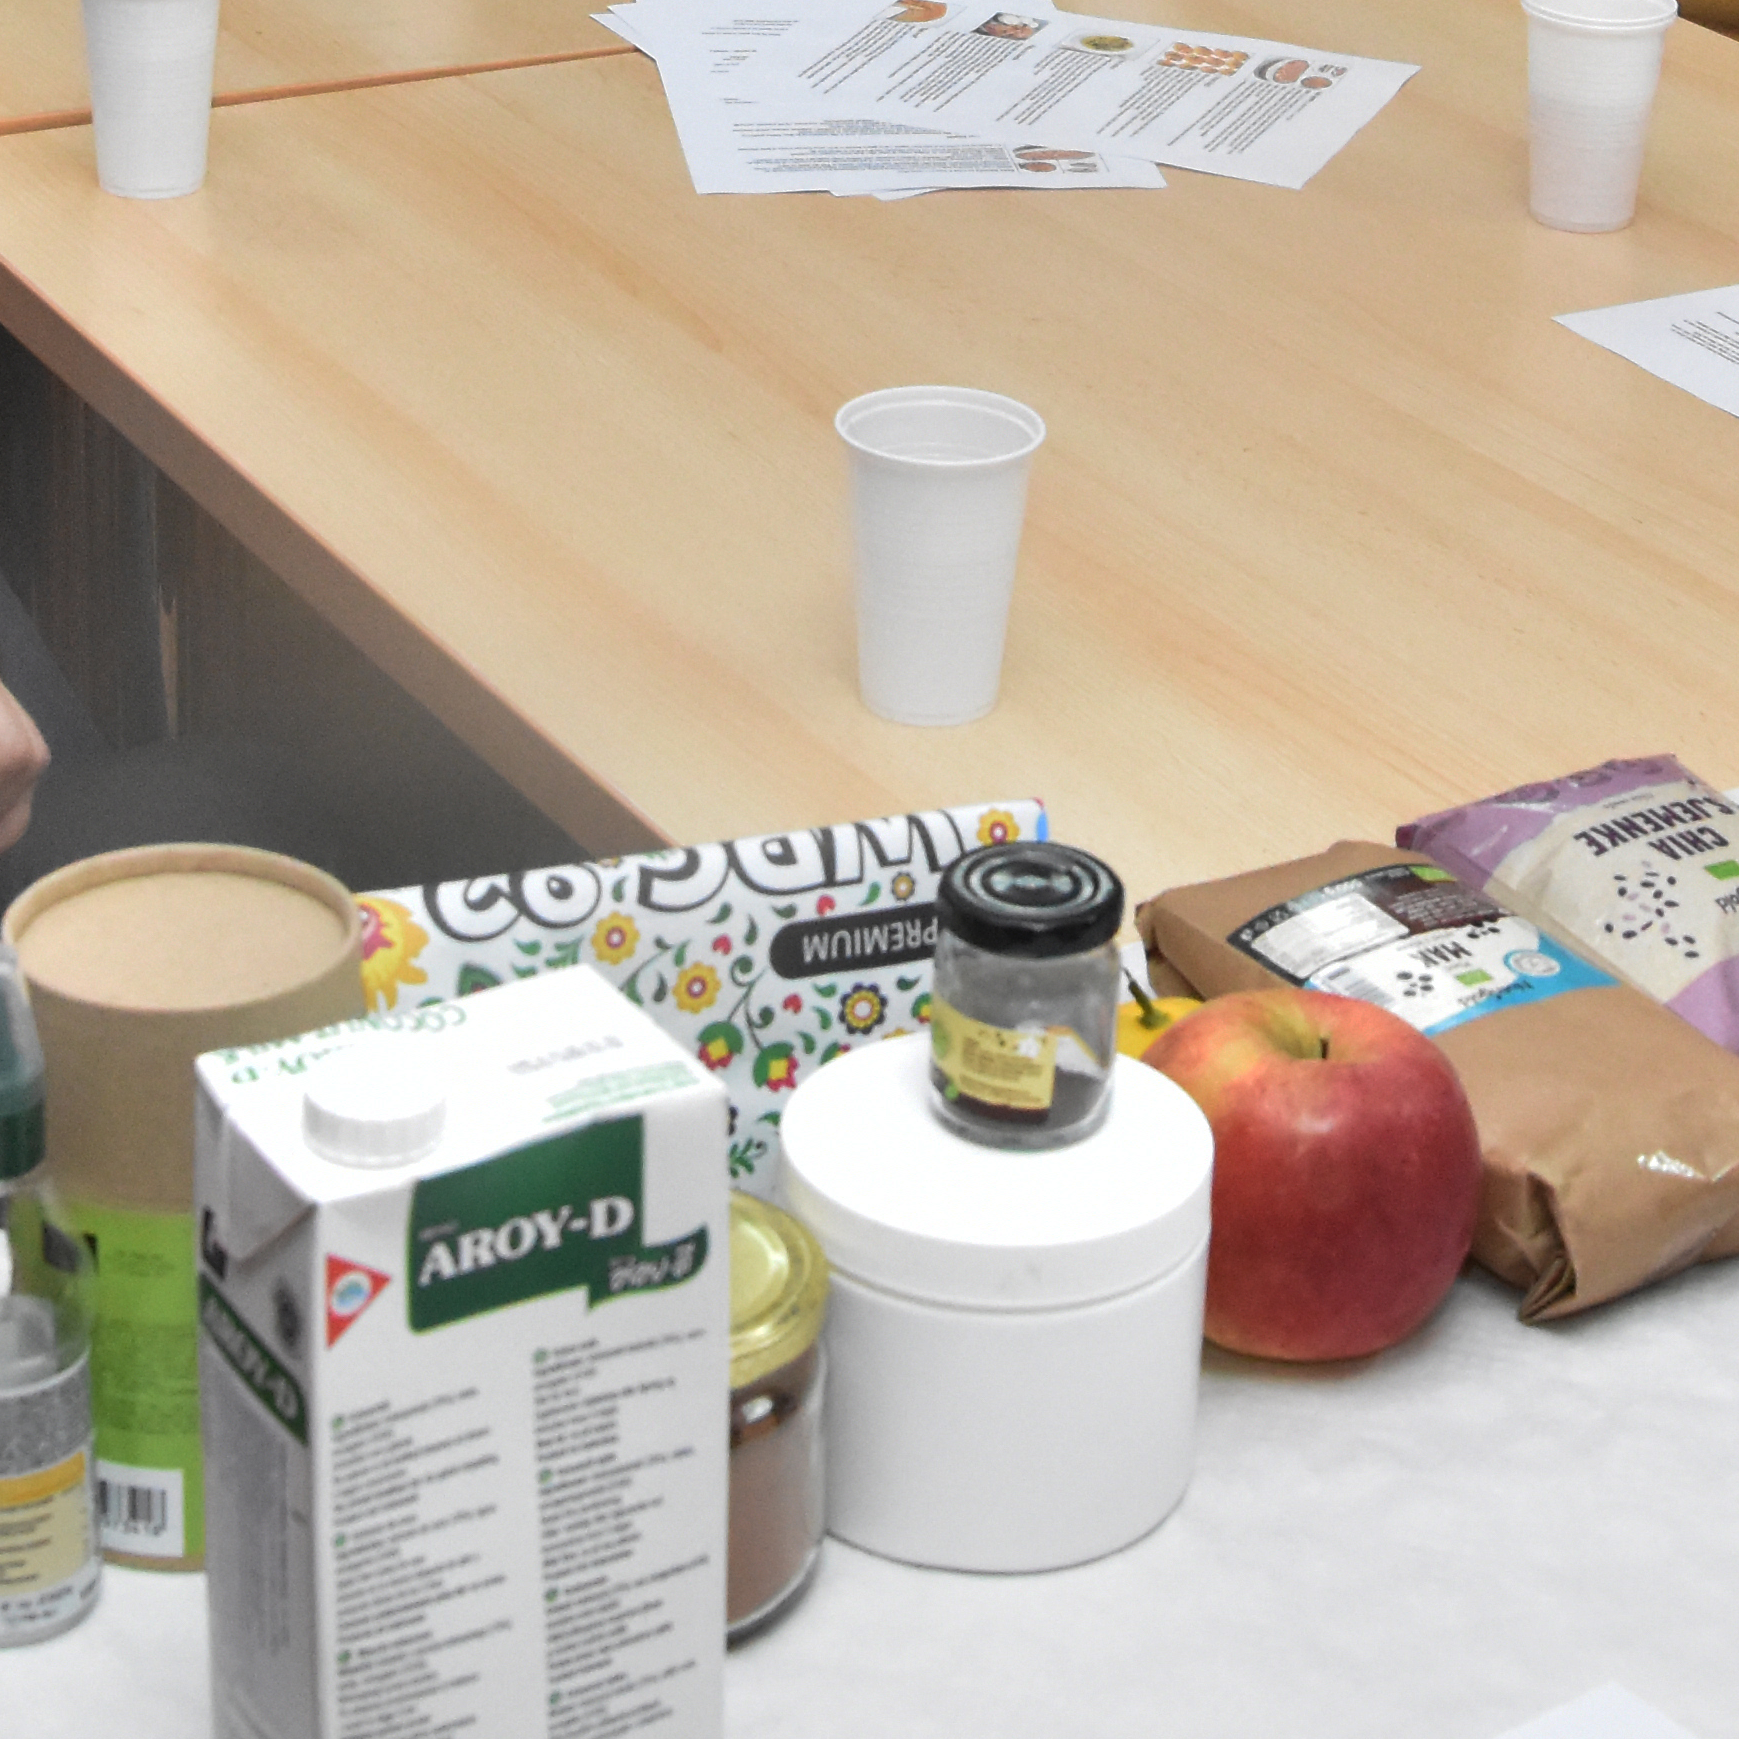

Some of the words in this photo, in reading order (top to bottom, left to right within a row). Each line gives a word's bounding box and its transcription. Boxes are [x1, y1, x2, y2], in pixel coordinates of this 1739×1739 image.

[1647, 825, 1730, 862] CHIA
[801, 916, 939, 963] PREMIUM
[416, 1195, 635, 1286] AROY-D
